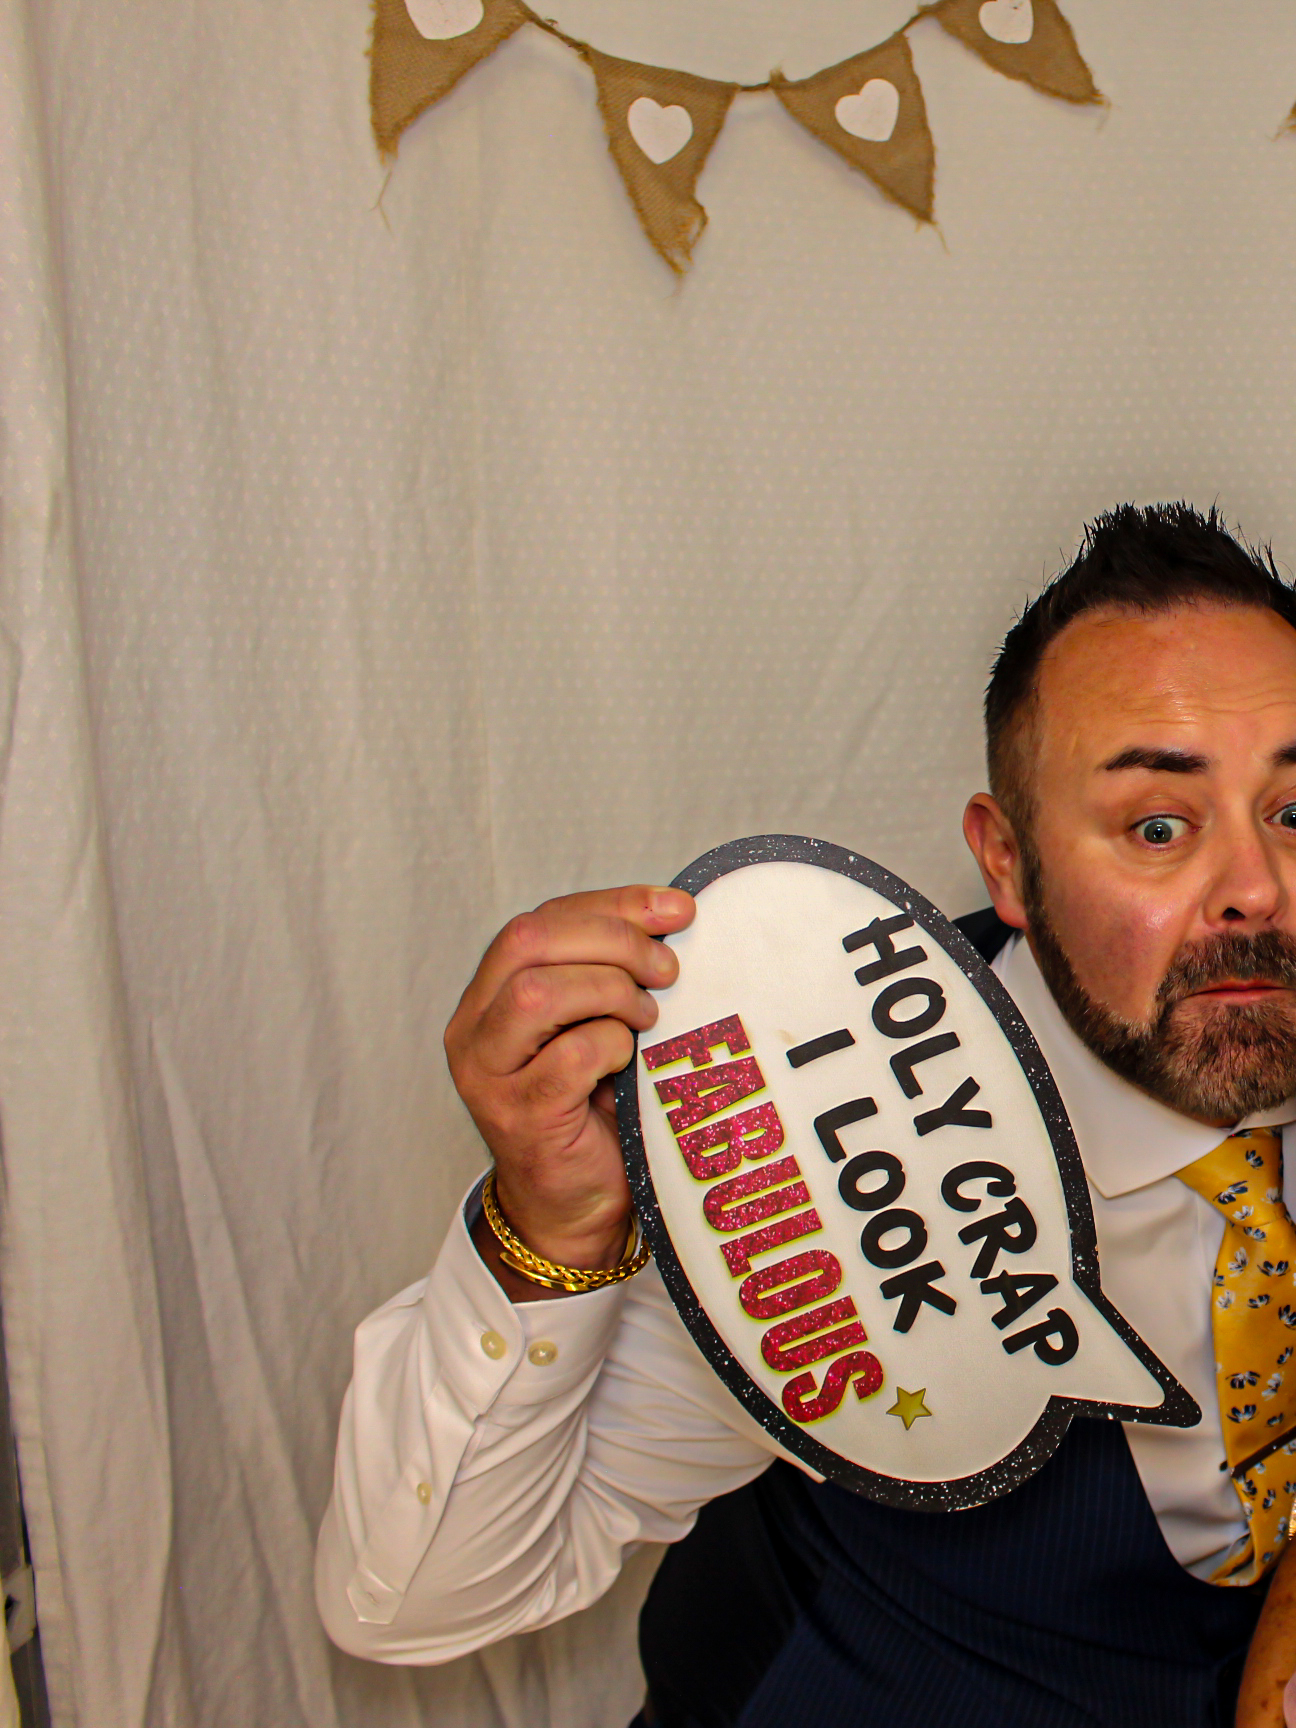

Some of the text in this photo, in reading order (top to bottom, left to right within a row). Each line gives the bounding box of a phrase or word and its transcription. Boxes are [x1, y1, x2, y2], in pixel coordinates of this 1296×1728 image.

[640, 1012, 884, 1423] FABULOUS
[785, 1028, 957, 1334] I LOOK
[842, 912, 1079, 1366] HOLY CRAP
